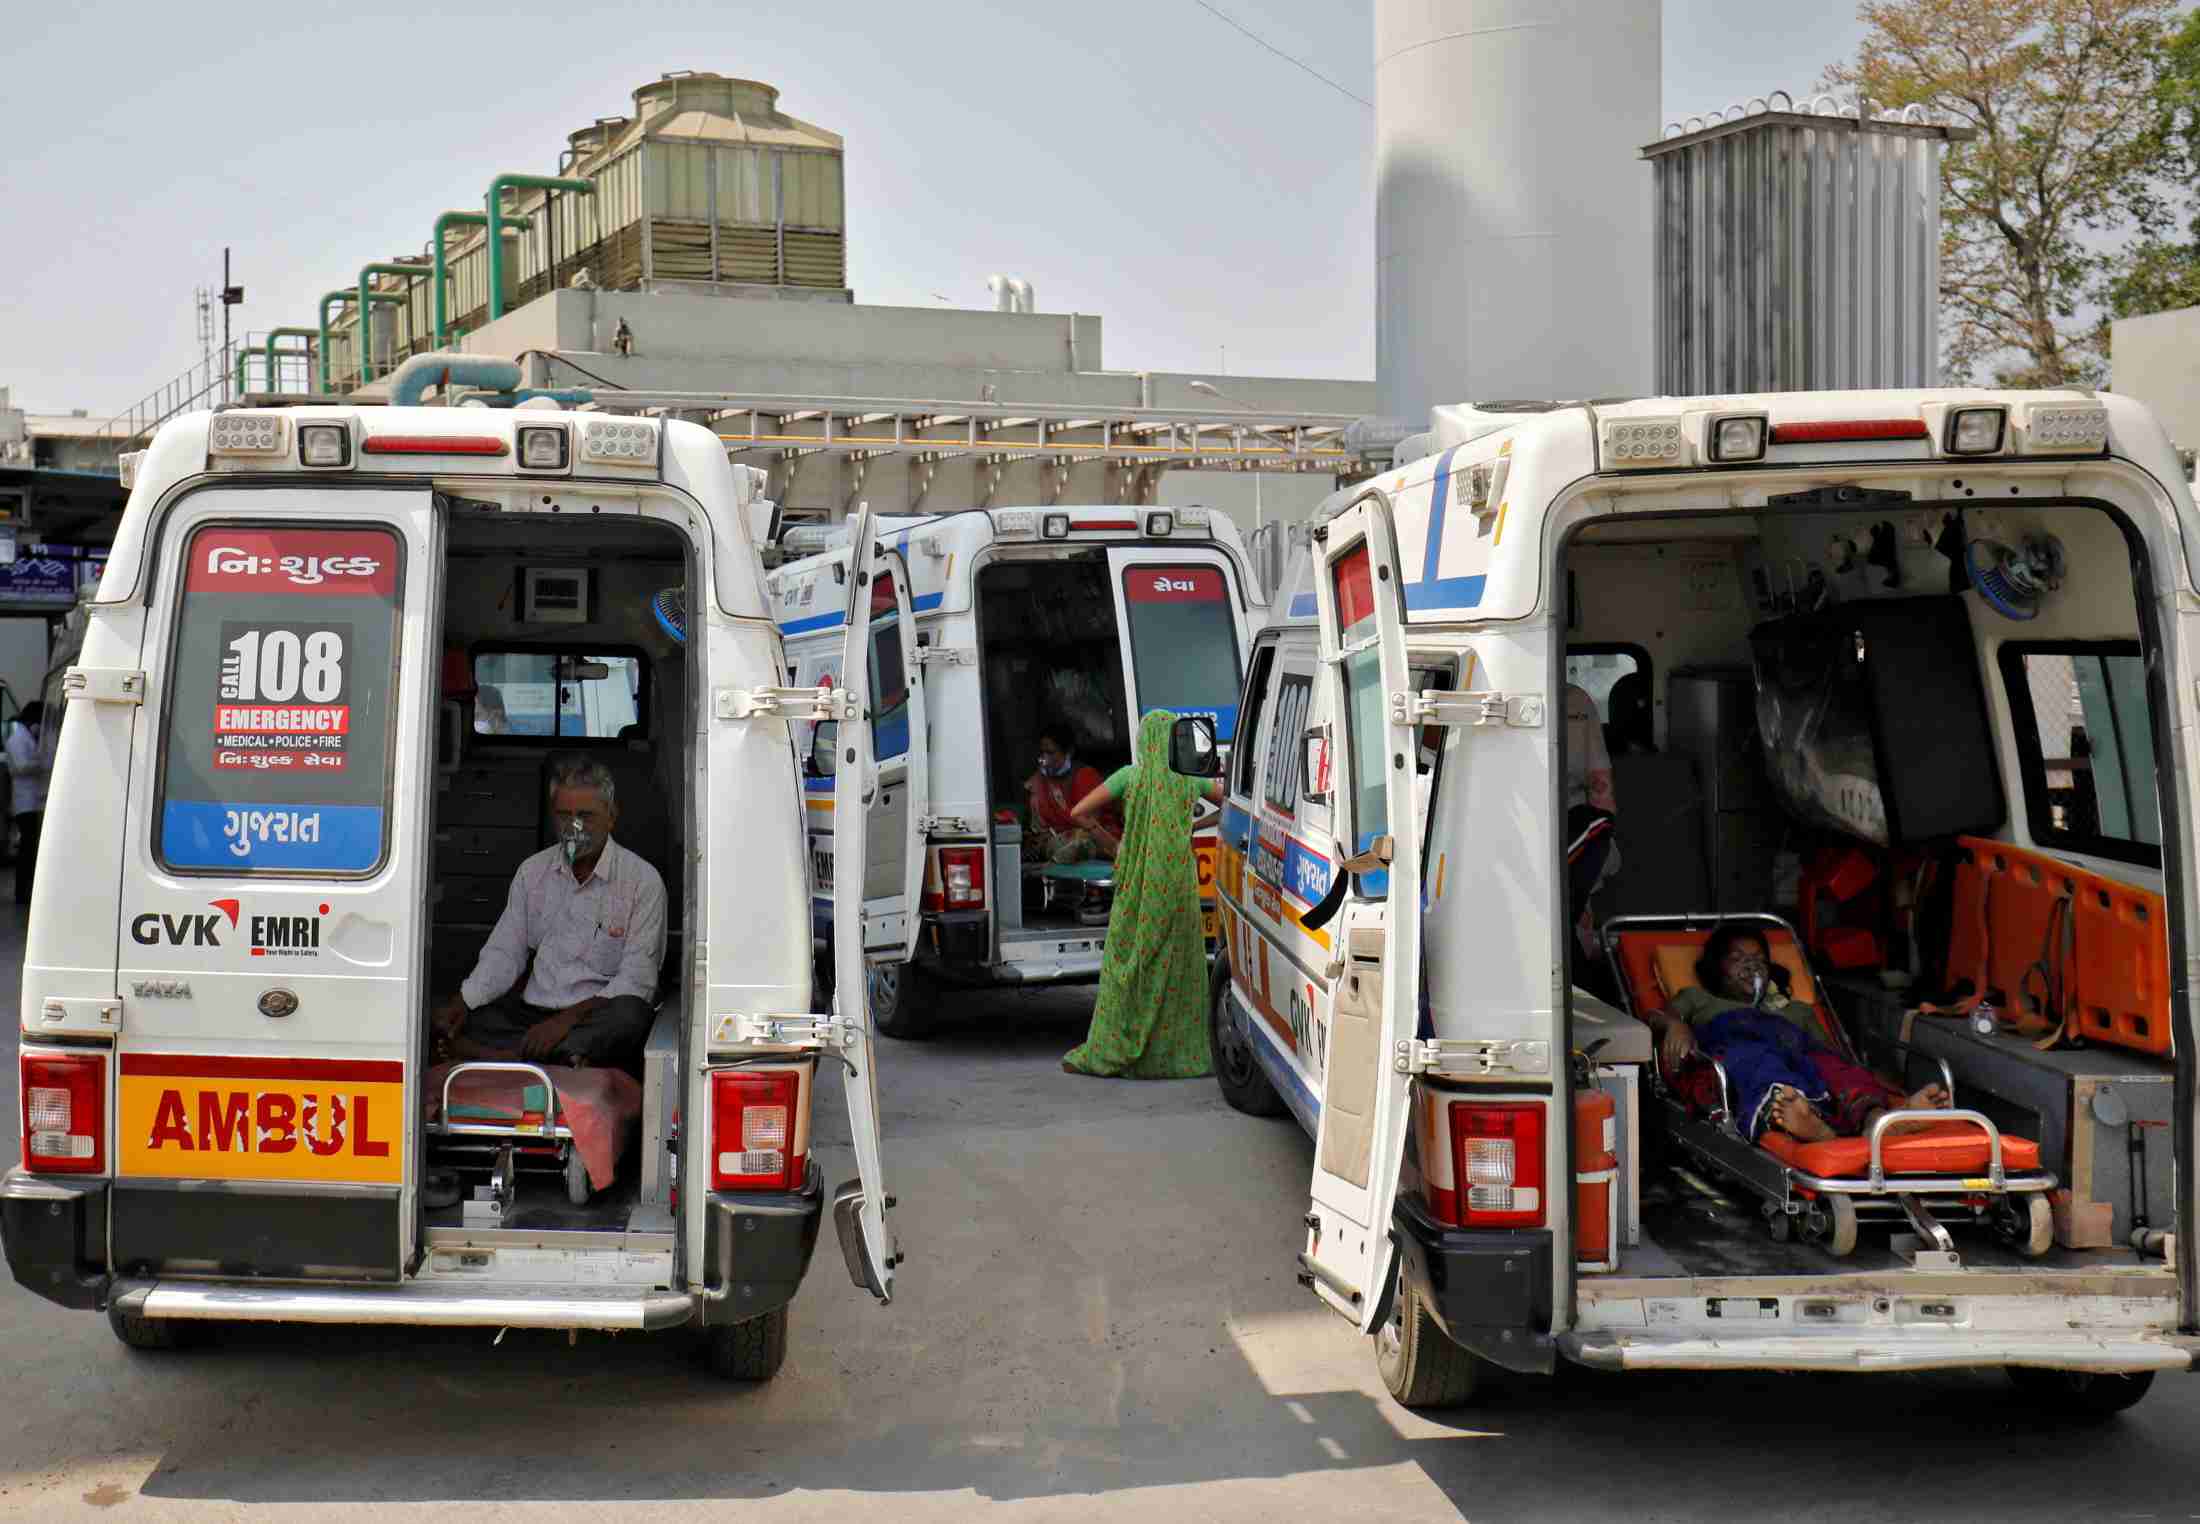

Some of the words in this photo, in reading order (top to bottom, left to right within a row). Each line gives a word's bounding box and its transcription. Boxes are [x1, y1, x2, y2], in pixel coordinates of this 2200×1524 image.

[1153, 576, 1195, 592] સેવા
[220, 656, 240, 699] CALL
[229, 630, 343, 703] 108
[220, 709, 344, 730] EMERGENCY
[223, 735, 268, 748] MEDICAL
[275, 736, 312, 748] POLICE
[319, 736, 342, 748] FIRE
[303, 753, 342, 766] સેવા
[223, 810, 320, 857] ગુજરાત
[131, 912, 222, 946] GVK
[251, 916, 320, 947] EMRI
[147, 1089, 390, 1157] AMBUL
